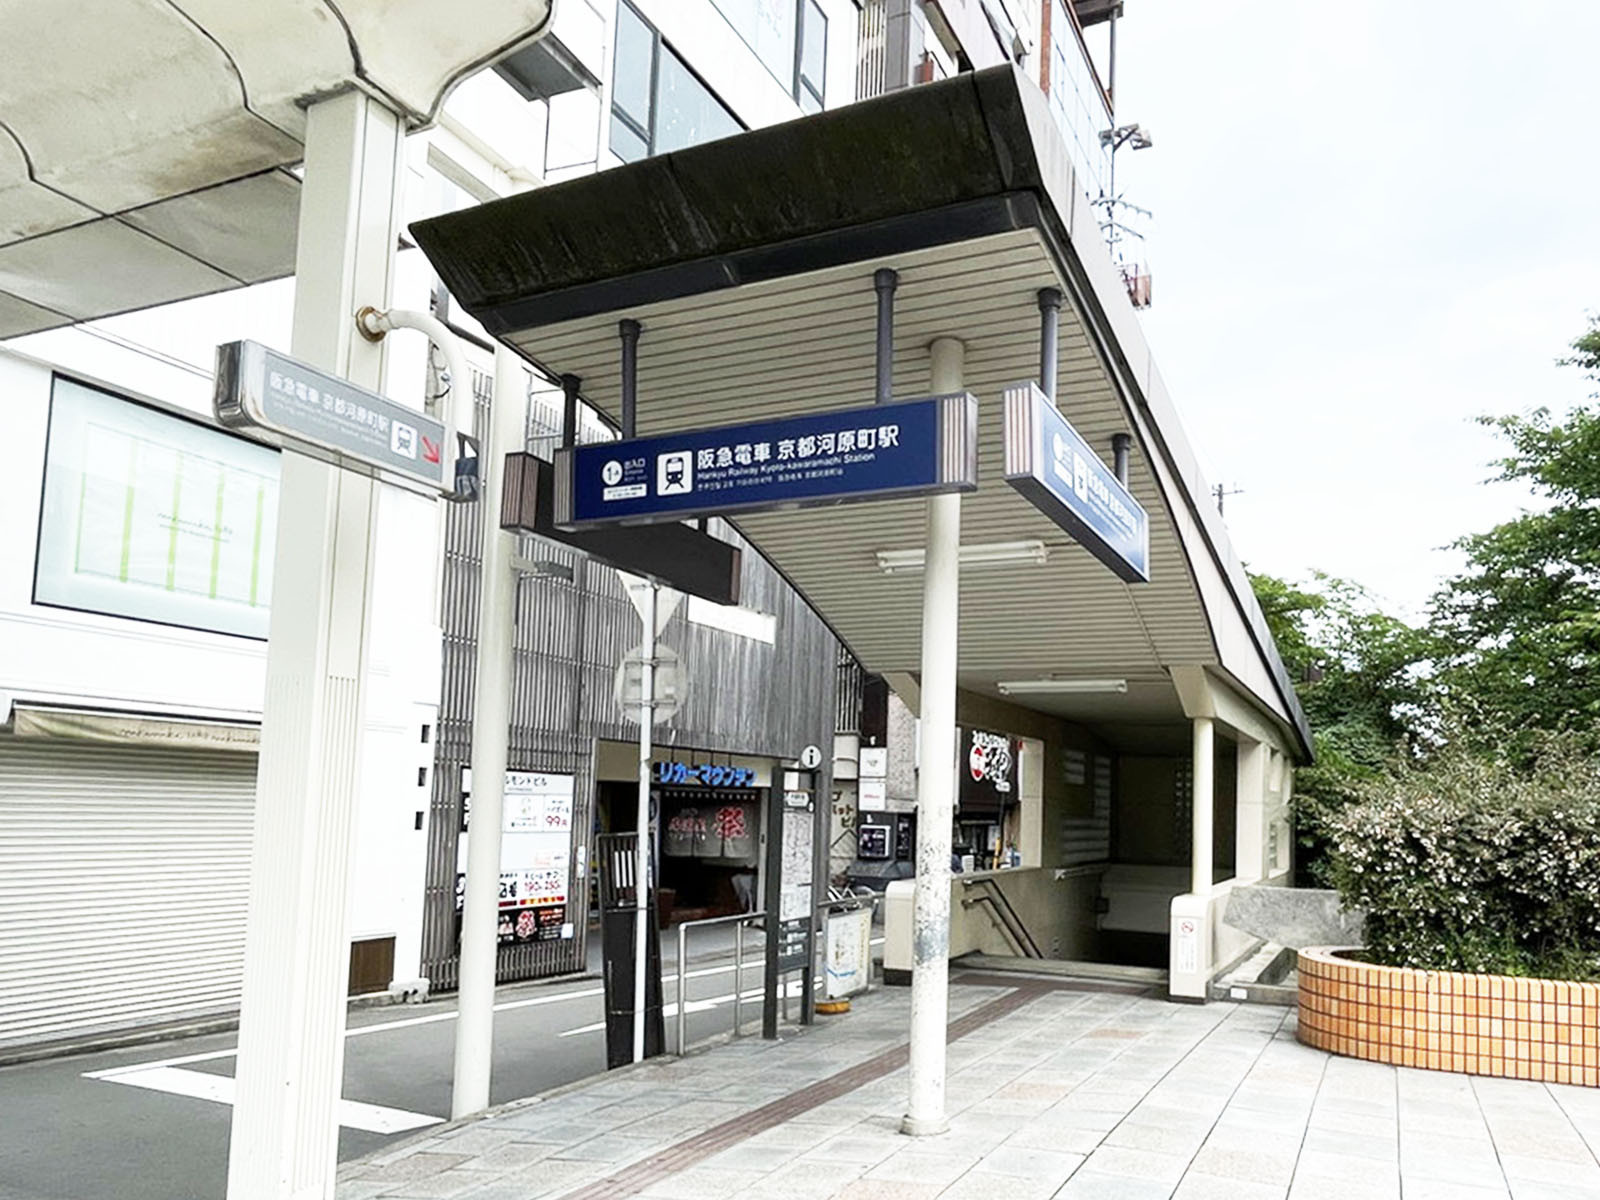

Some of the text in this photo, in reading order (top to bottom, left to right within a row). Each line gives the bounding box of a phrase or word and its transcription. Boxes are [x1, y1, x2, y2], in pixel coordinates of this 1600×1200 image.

[697, 424, 899, 470] 阪急電車 京都河原町駅
[728, 467, 759, 477] Railway
[843, 451, 876, 464] Station
[659, 761, 757, 787] リカーマウンテン
